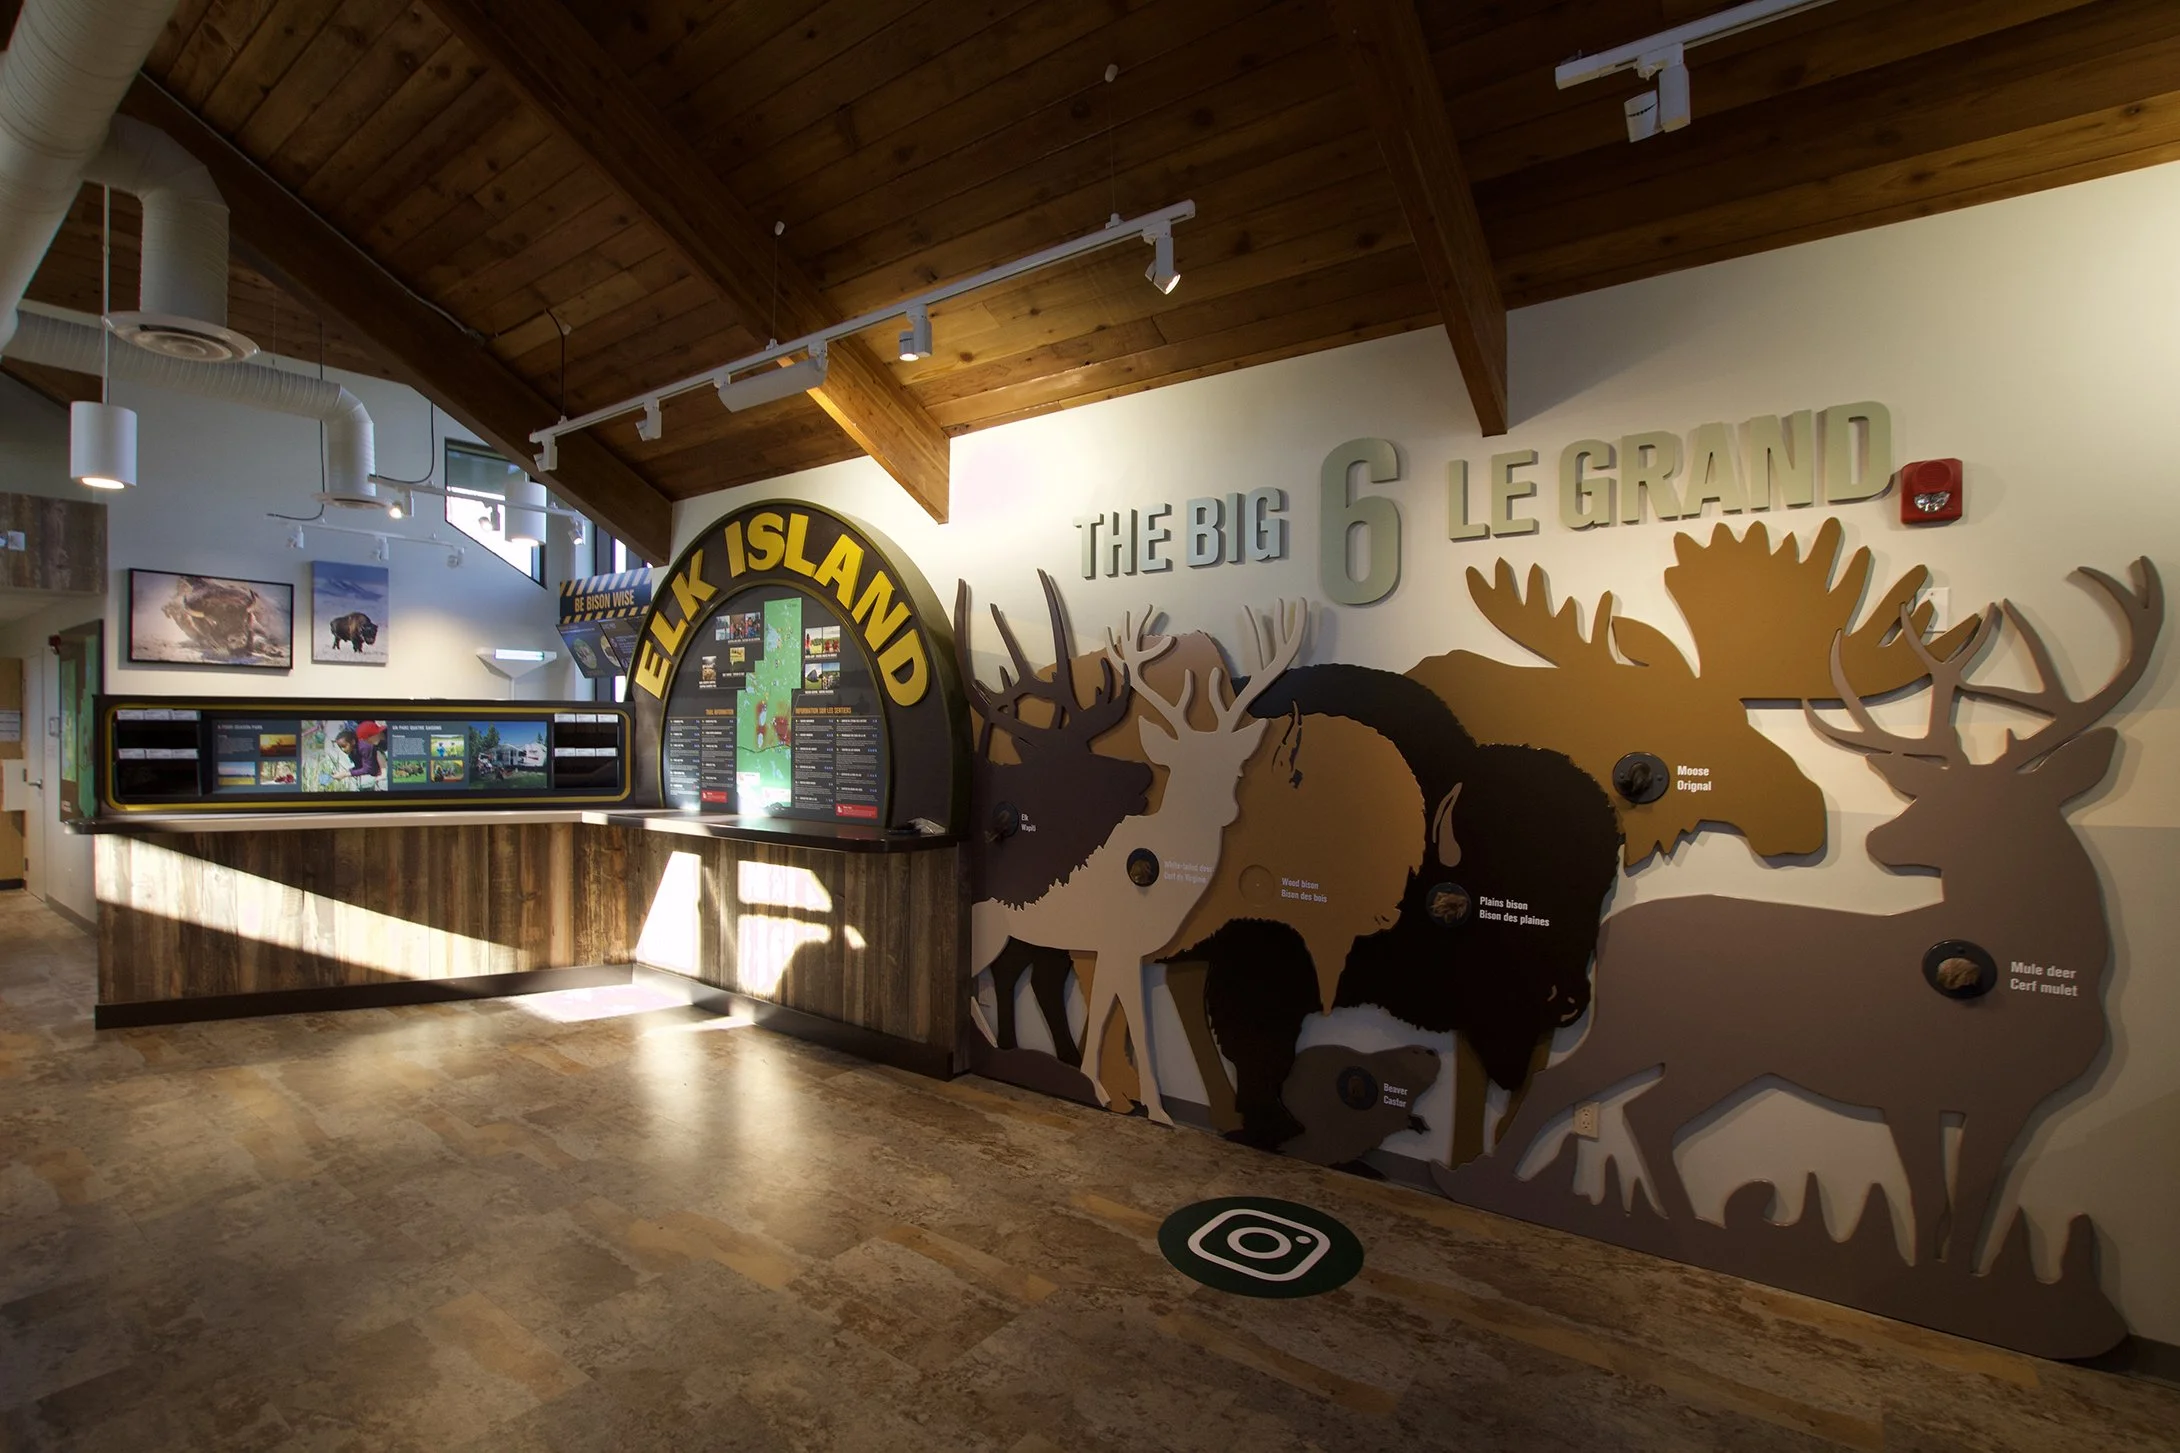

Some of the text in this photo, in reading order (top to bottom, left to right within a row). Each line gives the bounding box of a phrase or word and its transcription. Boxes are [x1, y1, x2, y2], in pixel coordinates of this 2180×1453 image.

[1073, 401, 1893, 606] THE BIG 6 LE GRAND
[574, 589, 635, 613] BE BISON WISE
[635, 512, 930, 707] ELK ISLAND
[1677, 765, 1710, 776] Moose
[1677, 780, 1712, 793] Orignal
[1021, 813, 1029, 821] Elk
[1281, 877, 1319, 890] Wood bison
[1281, 889, 1327, 903] Bison des bois
[1480, 896, 1528, 910] Plains bison
[1479, 910, 1550, 927] Bison des plaines
[2010, 961, 2077, 979] Mule deer
[2010, 978, 2078, 997] Cerf mulet
[1383, 1082, 1408, 1095] Beaver
[1383, 1095, 1407, 1108] Castor
